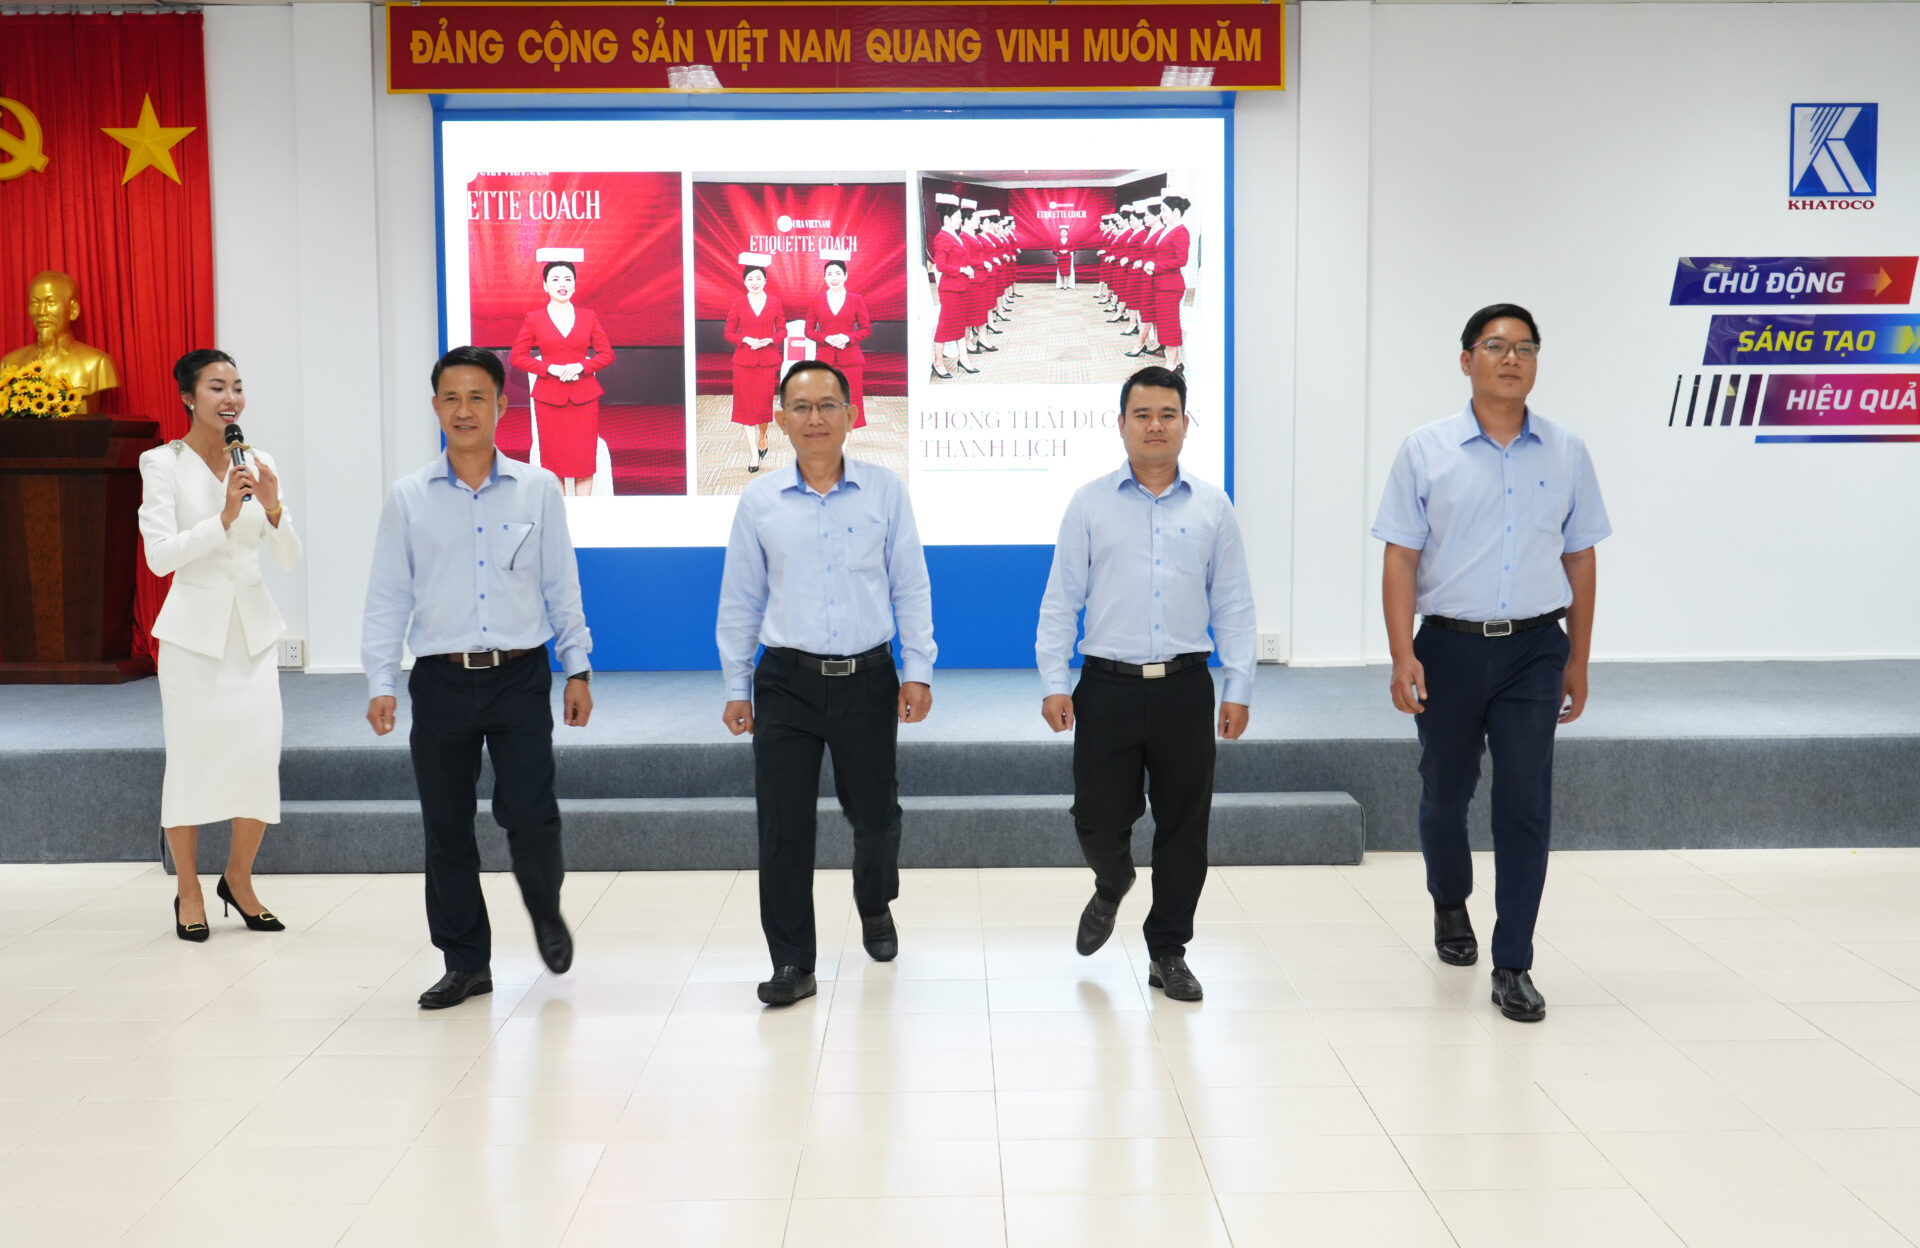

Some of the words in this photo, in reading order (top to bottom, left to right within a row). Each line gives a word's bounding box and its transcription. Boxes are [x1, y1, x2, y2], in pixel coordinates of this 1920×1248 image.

[410, 17, 504, 64] ĐẢNG
[518, 20, 618, 71] CỘNG
[631, 17, 694, 63] SẢN
[706, 20, 768, 71] VIỆT
[780, 28, 851, 63] NAM
[866, 28, 982, 63] QUANG
[997, 28, 1070, 62] VINH
[1084, 19, 1178, 62] MUÔN
[1190, 20, 1262, 62] NĂM
[467, 190, 521, 220] ETTE
[528, 190, 600, 220] COACH
[1788, 200, 1875, 210] KHATOCO
[750, 235, 815, 254] ETIQUETTE
[818, 235, 857, 252] COACH
[1703, 265, 1760, 294] CHỦ
[1766, 266, 1846, 299] ĐỘNG
[1737, 325, 1815, 352] SÁNG
[1823, 330, 1876, 357] TẠO
[1786, 383, 1853, 416] HIỆU
[1859, 381, 1917, 413] QUẢ
[920, 410, 1000, 430] PHONG
[920, 439, 1004, 458] THANH
[1012, 439, 1067, 460] LỊCH
